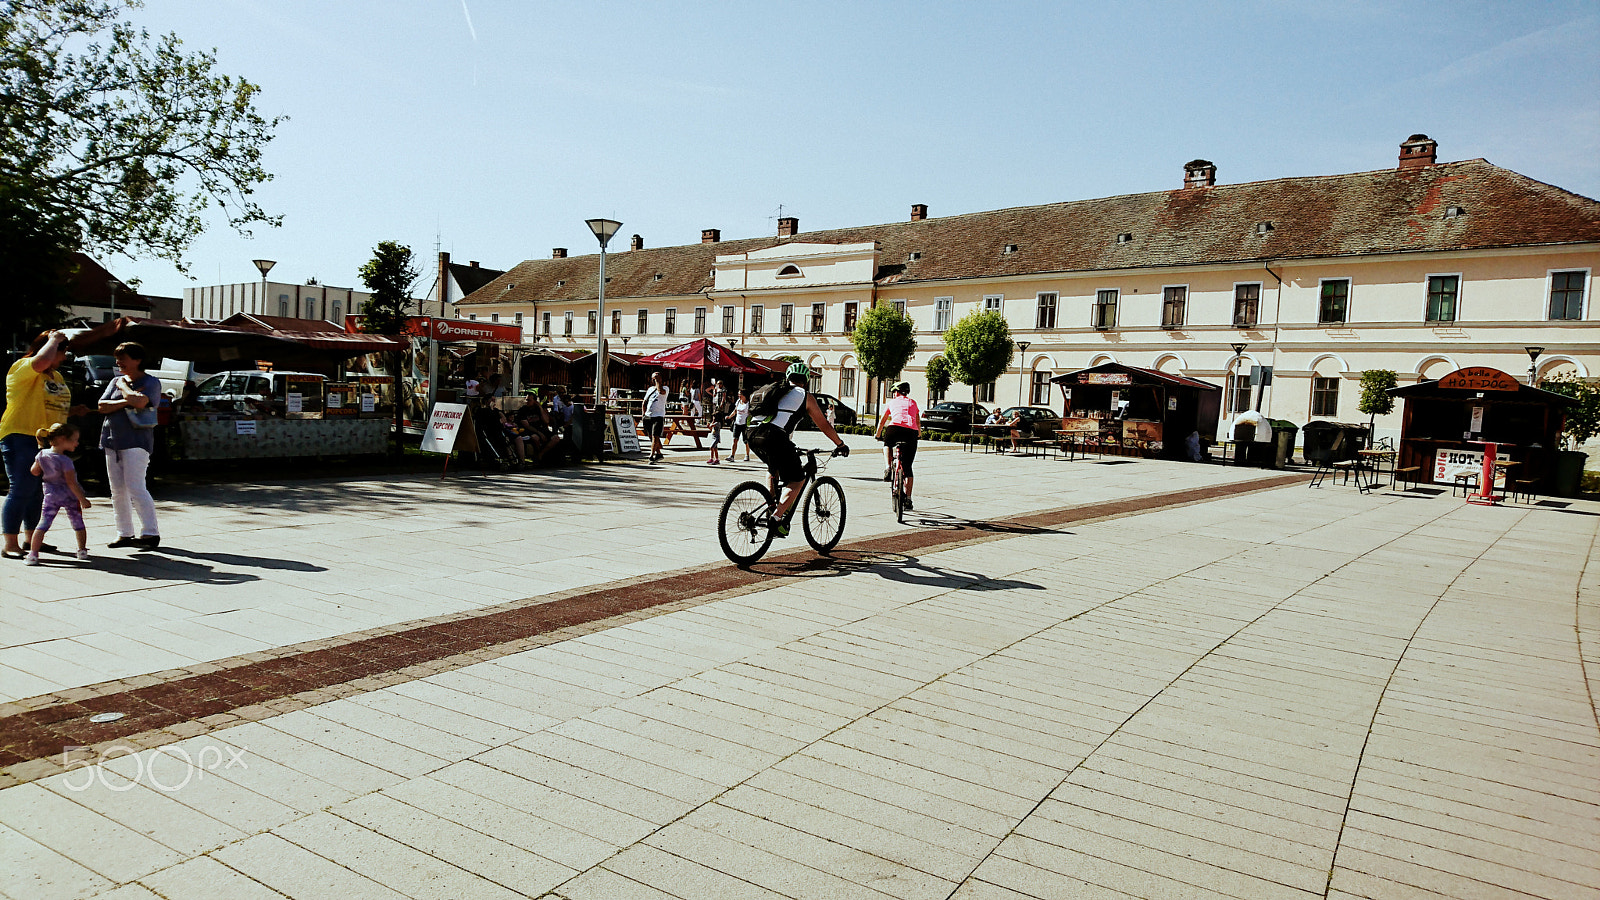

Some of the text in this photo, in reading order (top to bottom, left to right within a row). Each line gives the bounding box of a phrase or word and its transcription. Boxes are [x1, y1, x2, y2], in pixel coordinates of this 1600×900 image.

[448, 327, 493, 337] FORNETTI
[1449, 378, 1509, 389] HOT-DOG
[432, 421, 455, 431] POPCORN
